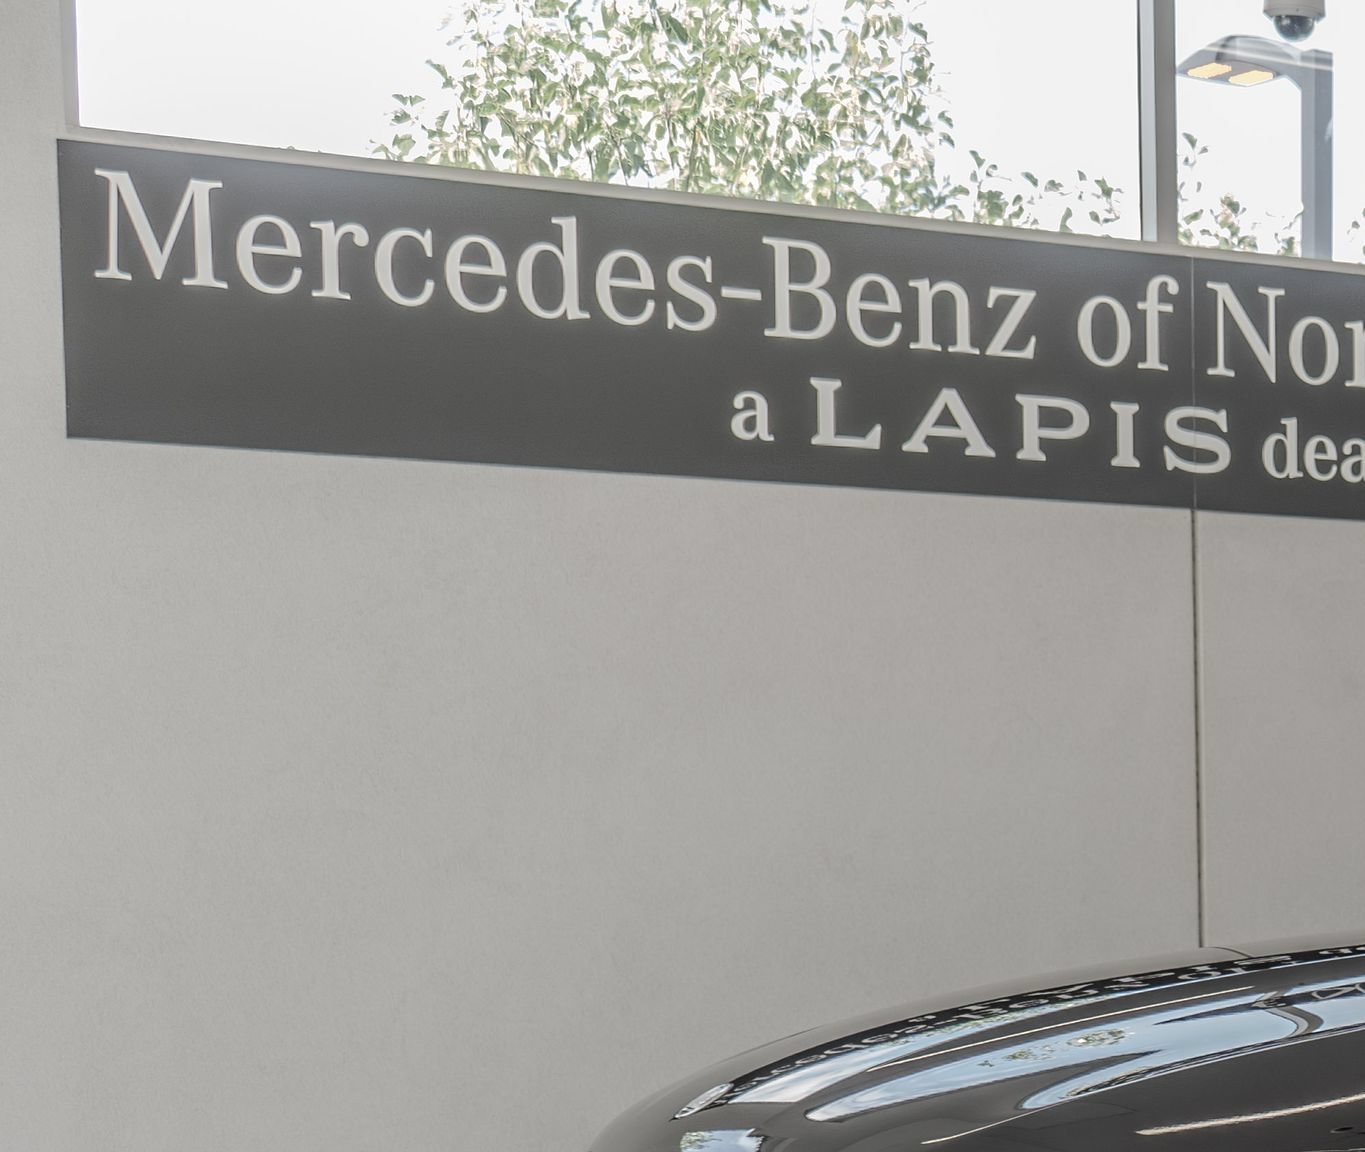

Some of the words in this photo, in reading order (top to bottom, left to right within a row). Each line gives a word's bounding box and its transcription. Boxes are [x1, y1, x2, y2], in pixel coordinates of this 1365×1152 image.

[92, 167, 1038, 361] Mercedes-Benz
[1075, 274, 1178, 371] of
[729, 390, 775, 443] a
[809, 376, 1233, 475] LAPIS
